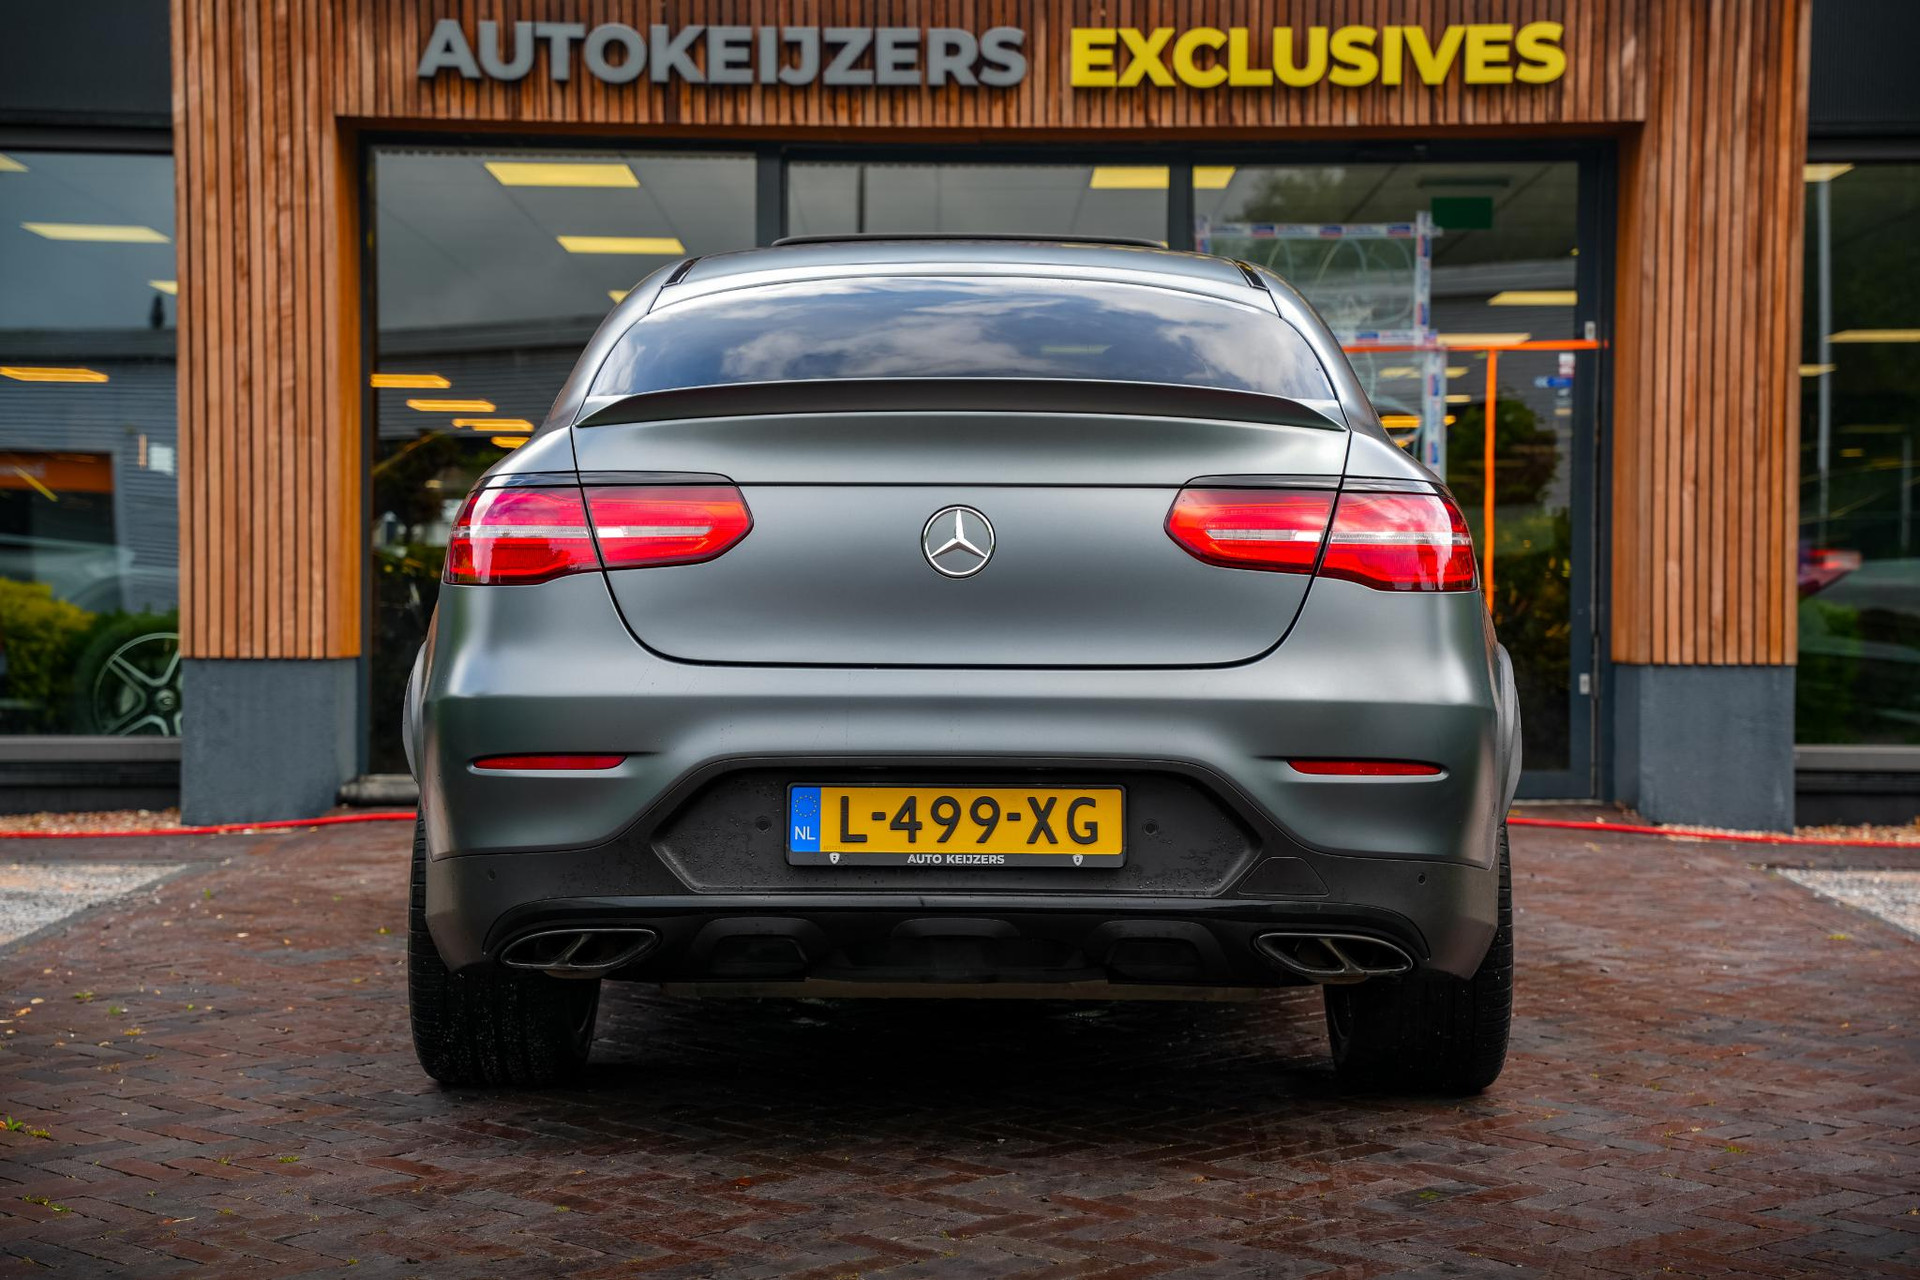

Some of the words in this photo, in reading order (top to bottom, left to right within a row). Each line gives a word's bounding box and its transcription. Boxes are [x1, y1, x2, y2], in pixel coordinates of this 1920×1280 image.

[417, 18, 1027, 87] AUTOKEIJZERS
[1070, 21, 1567, 88] EXCLUSIVES
[794, 826, 816, 841] NL
[839, 795, 1099, 845] L-499-XG
[907, 854, 942, 864] AUTO
[946, 854, 1005, 865] KEIJZERS
